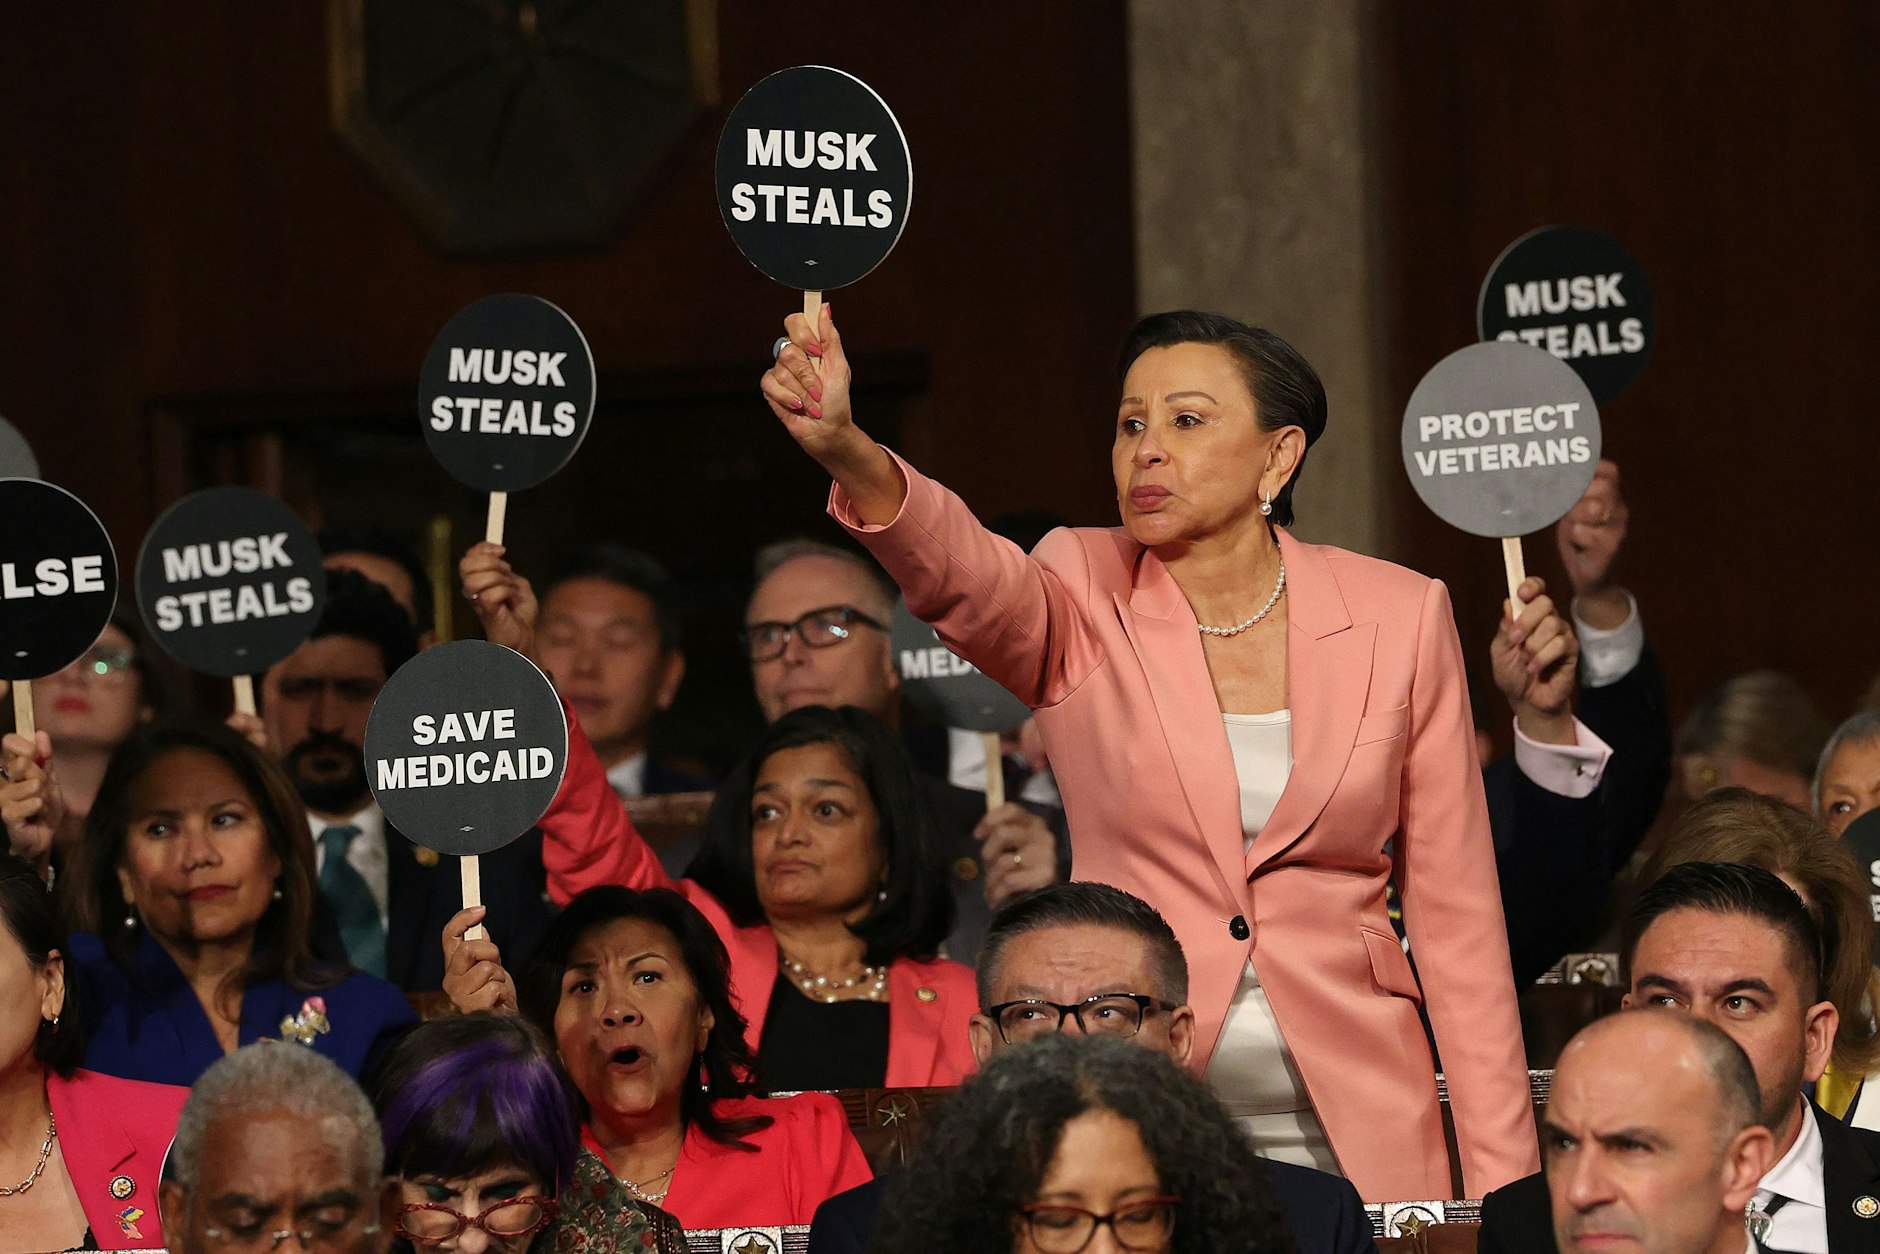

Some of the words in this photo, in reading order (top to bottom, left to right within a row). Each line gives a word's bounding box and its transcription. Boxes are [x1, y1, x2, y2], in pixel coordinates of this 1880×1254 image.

[746, 128, 879, 172] MUSK
[731, 182, 894, 229] STEALS
[1504, 272, 1627, 319] MUSK
[447, 347, 567, 388] MUSK
[430, 395, 577, 438] STEALS
[1418, 402, 1580, 443] PROTECT
[1413, 435, 1592, 477] VETERANS
[0, 554, 105, 600] LSE
[162, 531, 293, 584] MUSK
[154, 576, 315, 633] STEALS
[901, 646, 981, 679] MED
[412, 708, 517, 746] SAVE
[376, 747, 555, 791] MEDICAID
